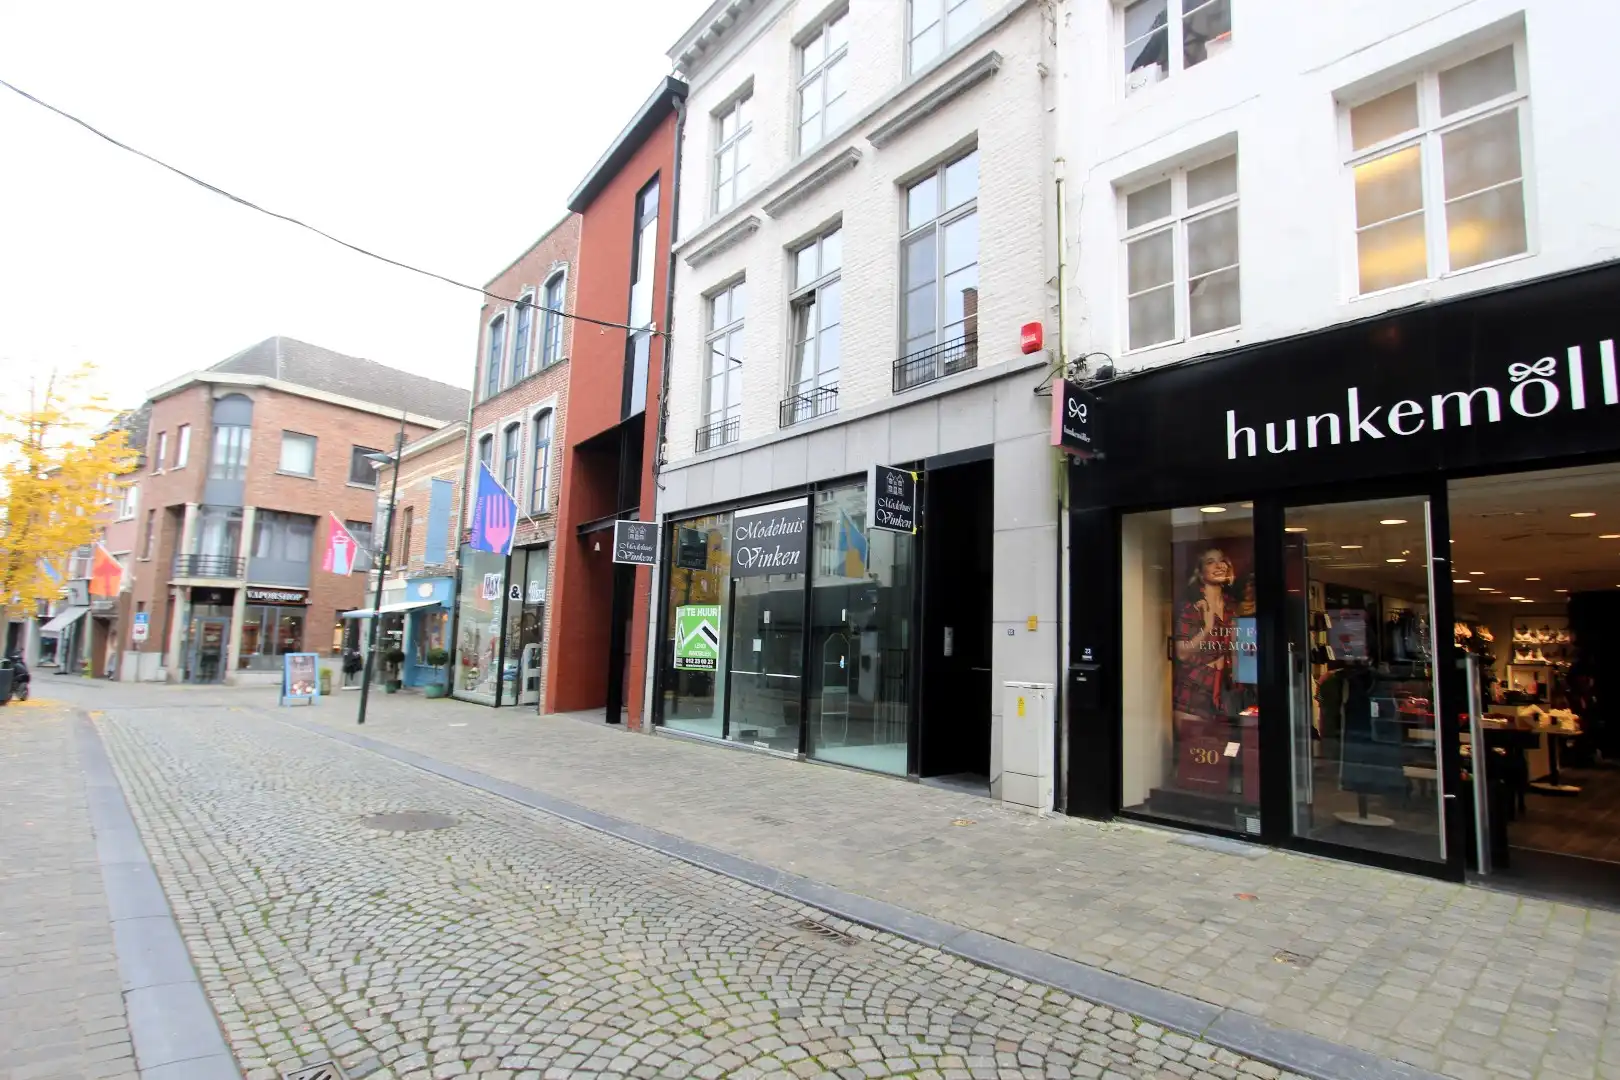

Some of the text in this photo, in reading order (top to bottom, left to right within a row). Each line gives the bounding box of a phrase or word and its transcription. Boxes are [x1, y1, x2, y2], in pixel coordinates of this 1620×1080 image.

[878, 496, 912, 513] Modehuis
[876, 508, 912, 528] Vinken
[735, 516, 806, 541] Modehuis
[618, 541, 655, 552] Modehuis
[616, 549, 654, 562] Vinken
[736, 544, 801, 569] Vinken
[246, 590, 303, 601] VAPORSHOP
[687, 607, 696, 616] TE
[697, 607, 718, 617] HUUR
[1210, 627, 1241, 637] GIFT
[1181, 640, 1227, 652] EVERY
